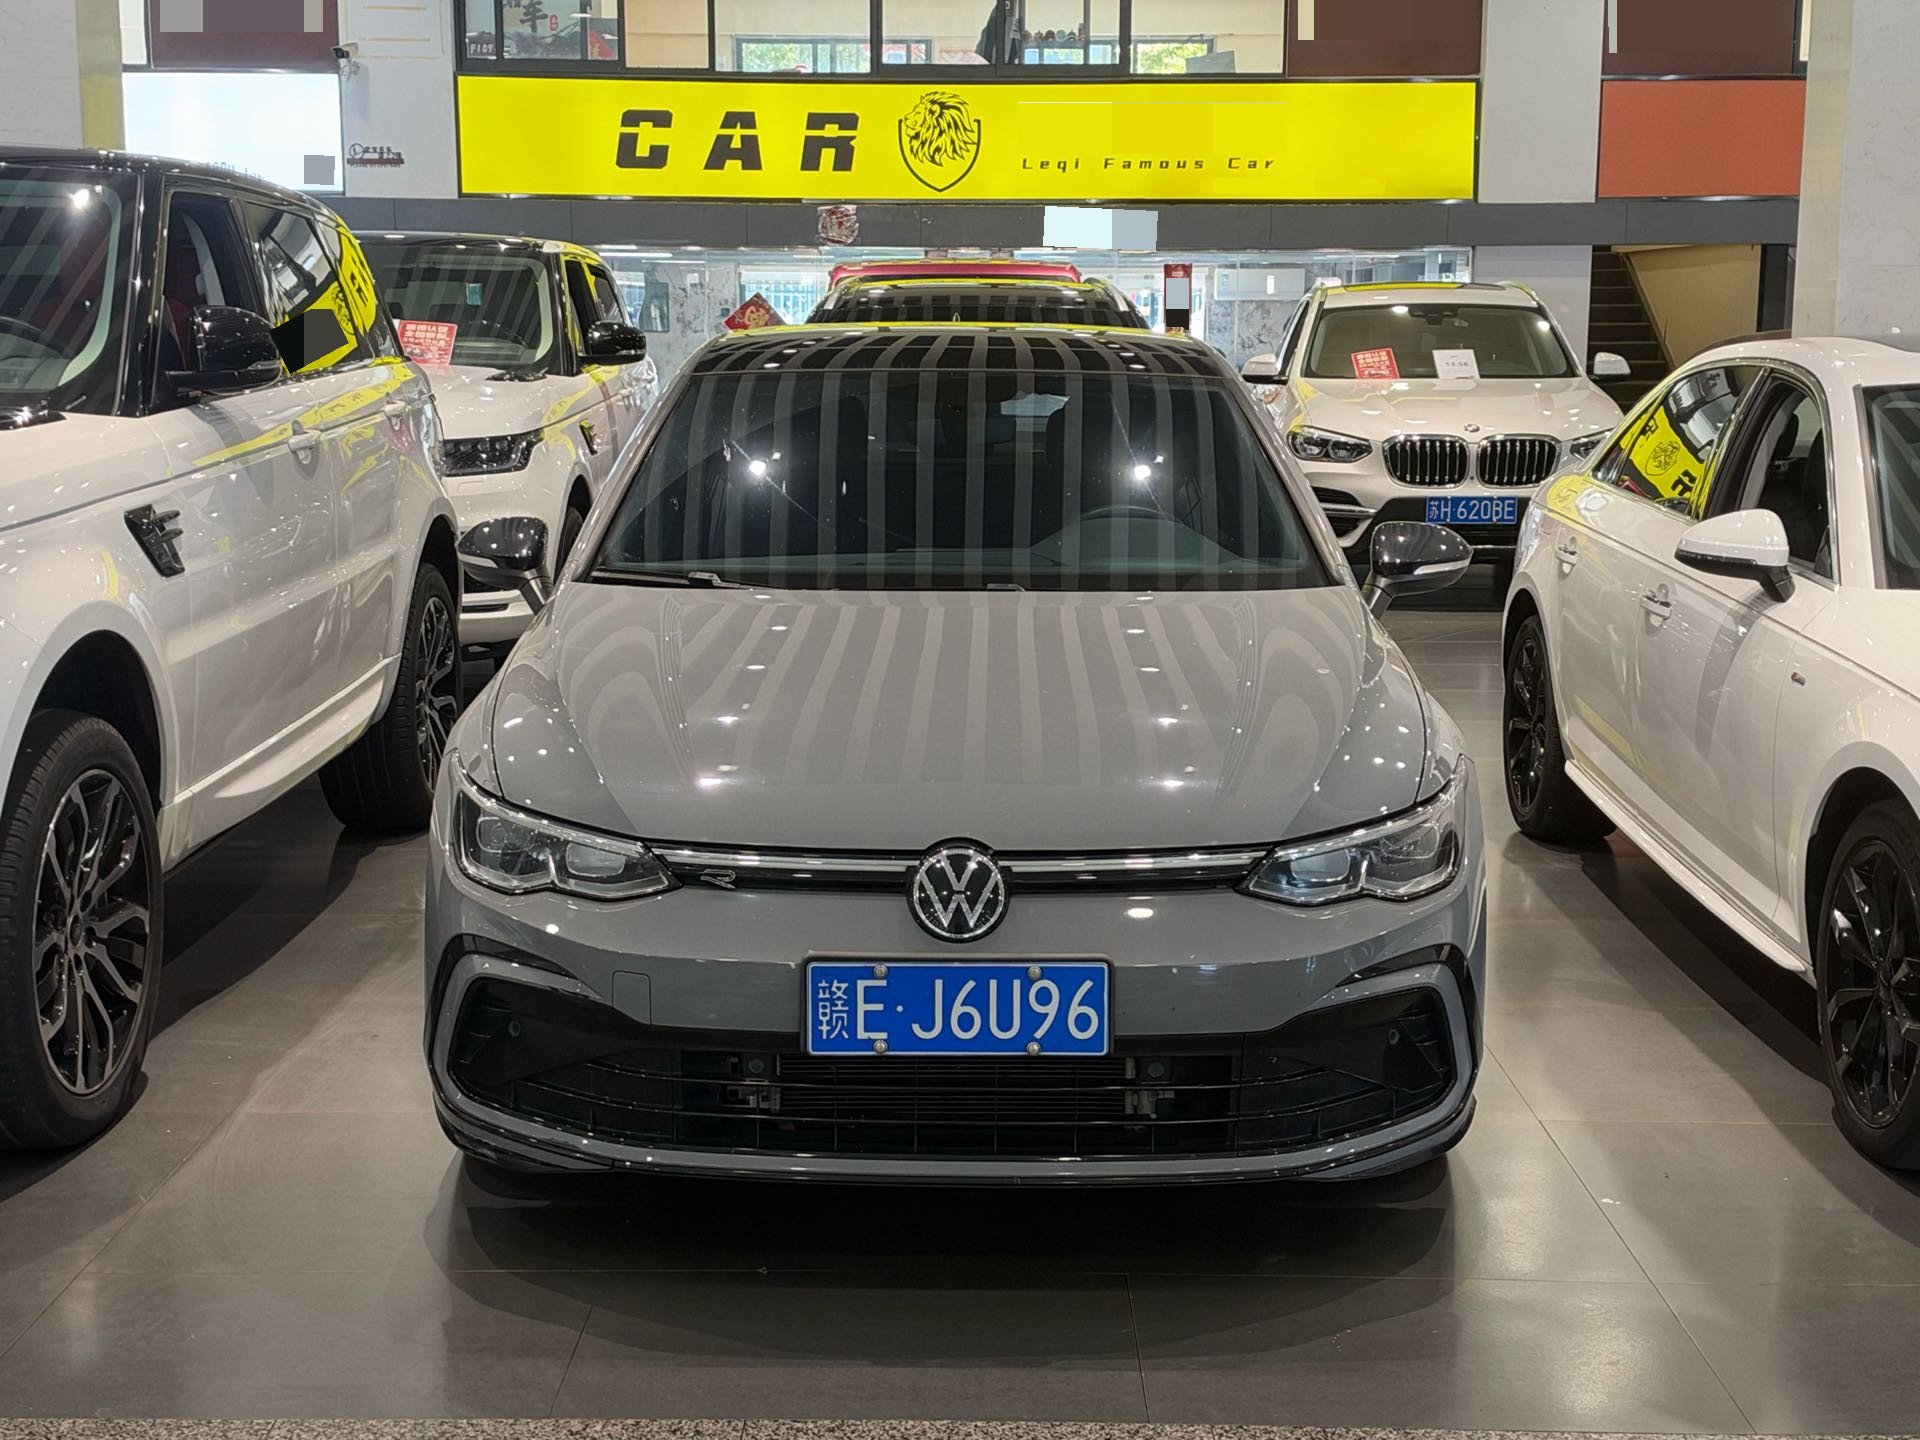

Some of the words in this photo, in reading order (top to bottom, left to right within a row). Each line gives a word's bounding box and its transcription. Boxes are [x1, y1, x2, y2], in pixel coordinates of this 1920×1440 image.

[616, 109, 859, 172] CAR
[1021, 157, 1080, 173] Leqi
[1103, 157, 1204, 170] Famous
[1227, 157, 1275, 170] Car
